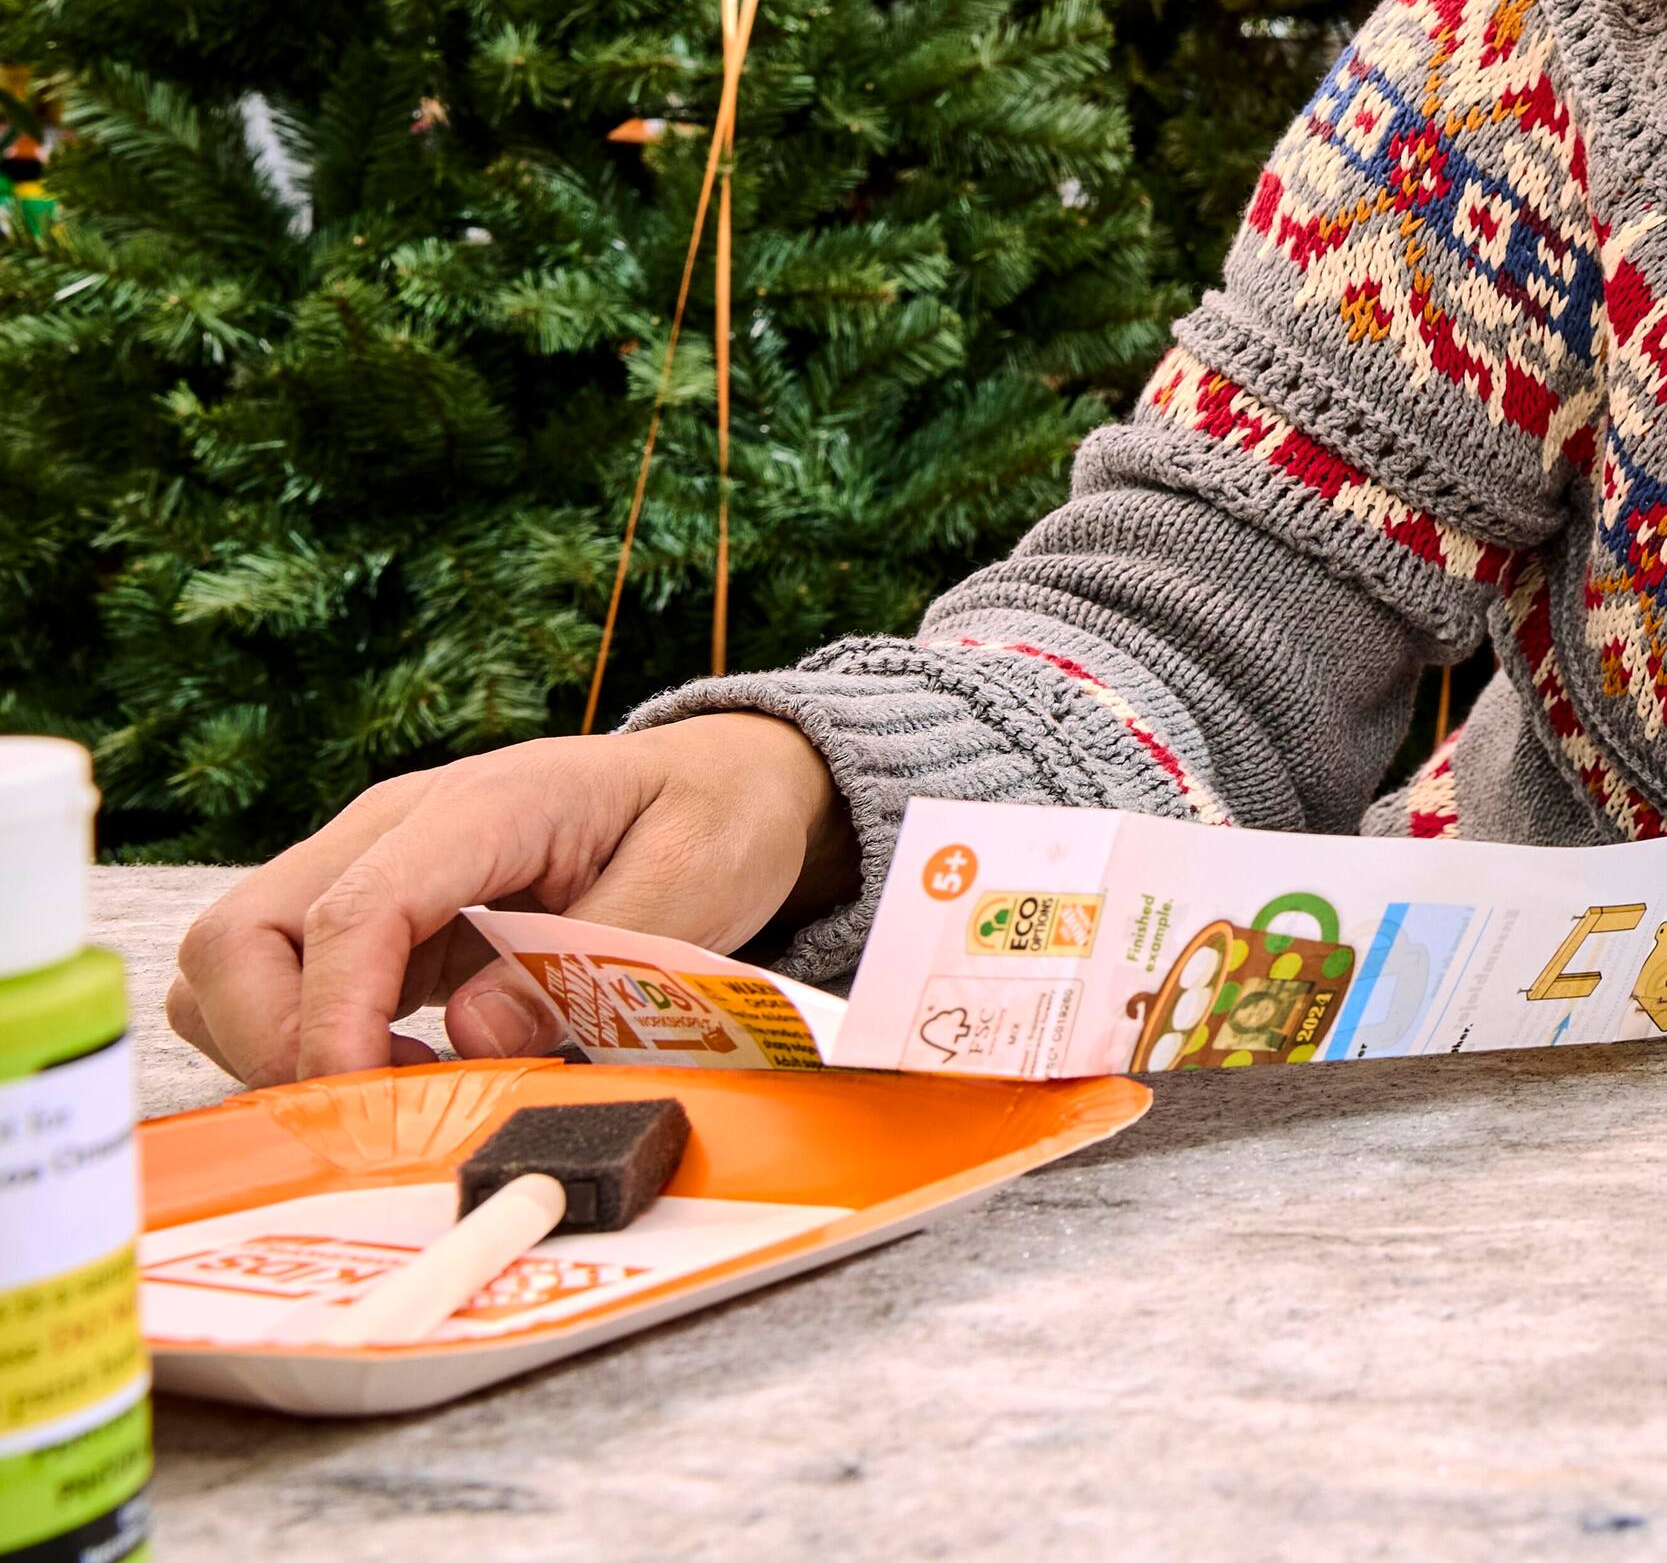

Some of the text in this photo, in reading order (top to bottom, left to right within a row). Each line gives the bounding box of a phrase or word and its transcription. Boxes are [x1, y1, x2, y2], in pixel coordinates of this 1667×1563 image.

[930, 849, 969, 893] 5+
[1010, 896, 1039, 951] ECO
[1030, 897, 1054, 951] OPTIONS
[1126, 893, 1154, 962] Finished
[1145, 898, 1173, 972] example.
[609, 974, 693, 1013] KIDS
[1295, 990, 1334, 1045] 2024
